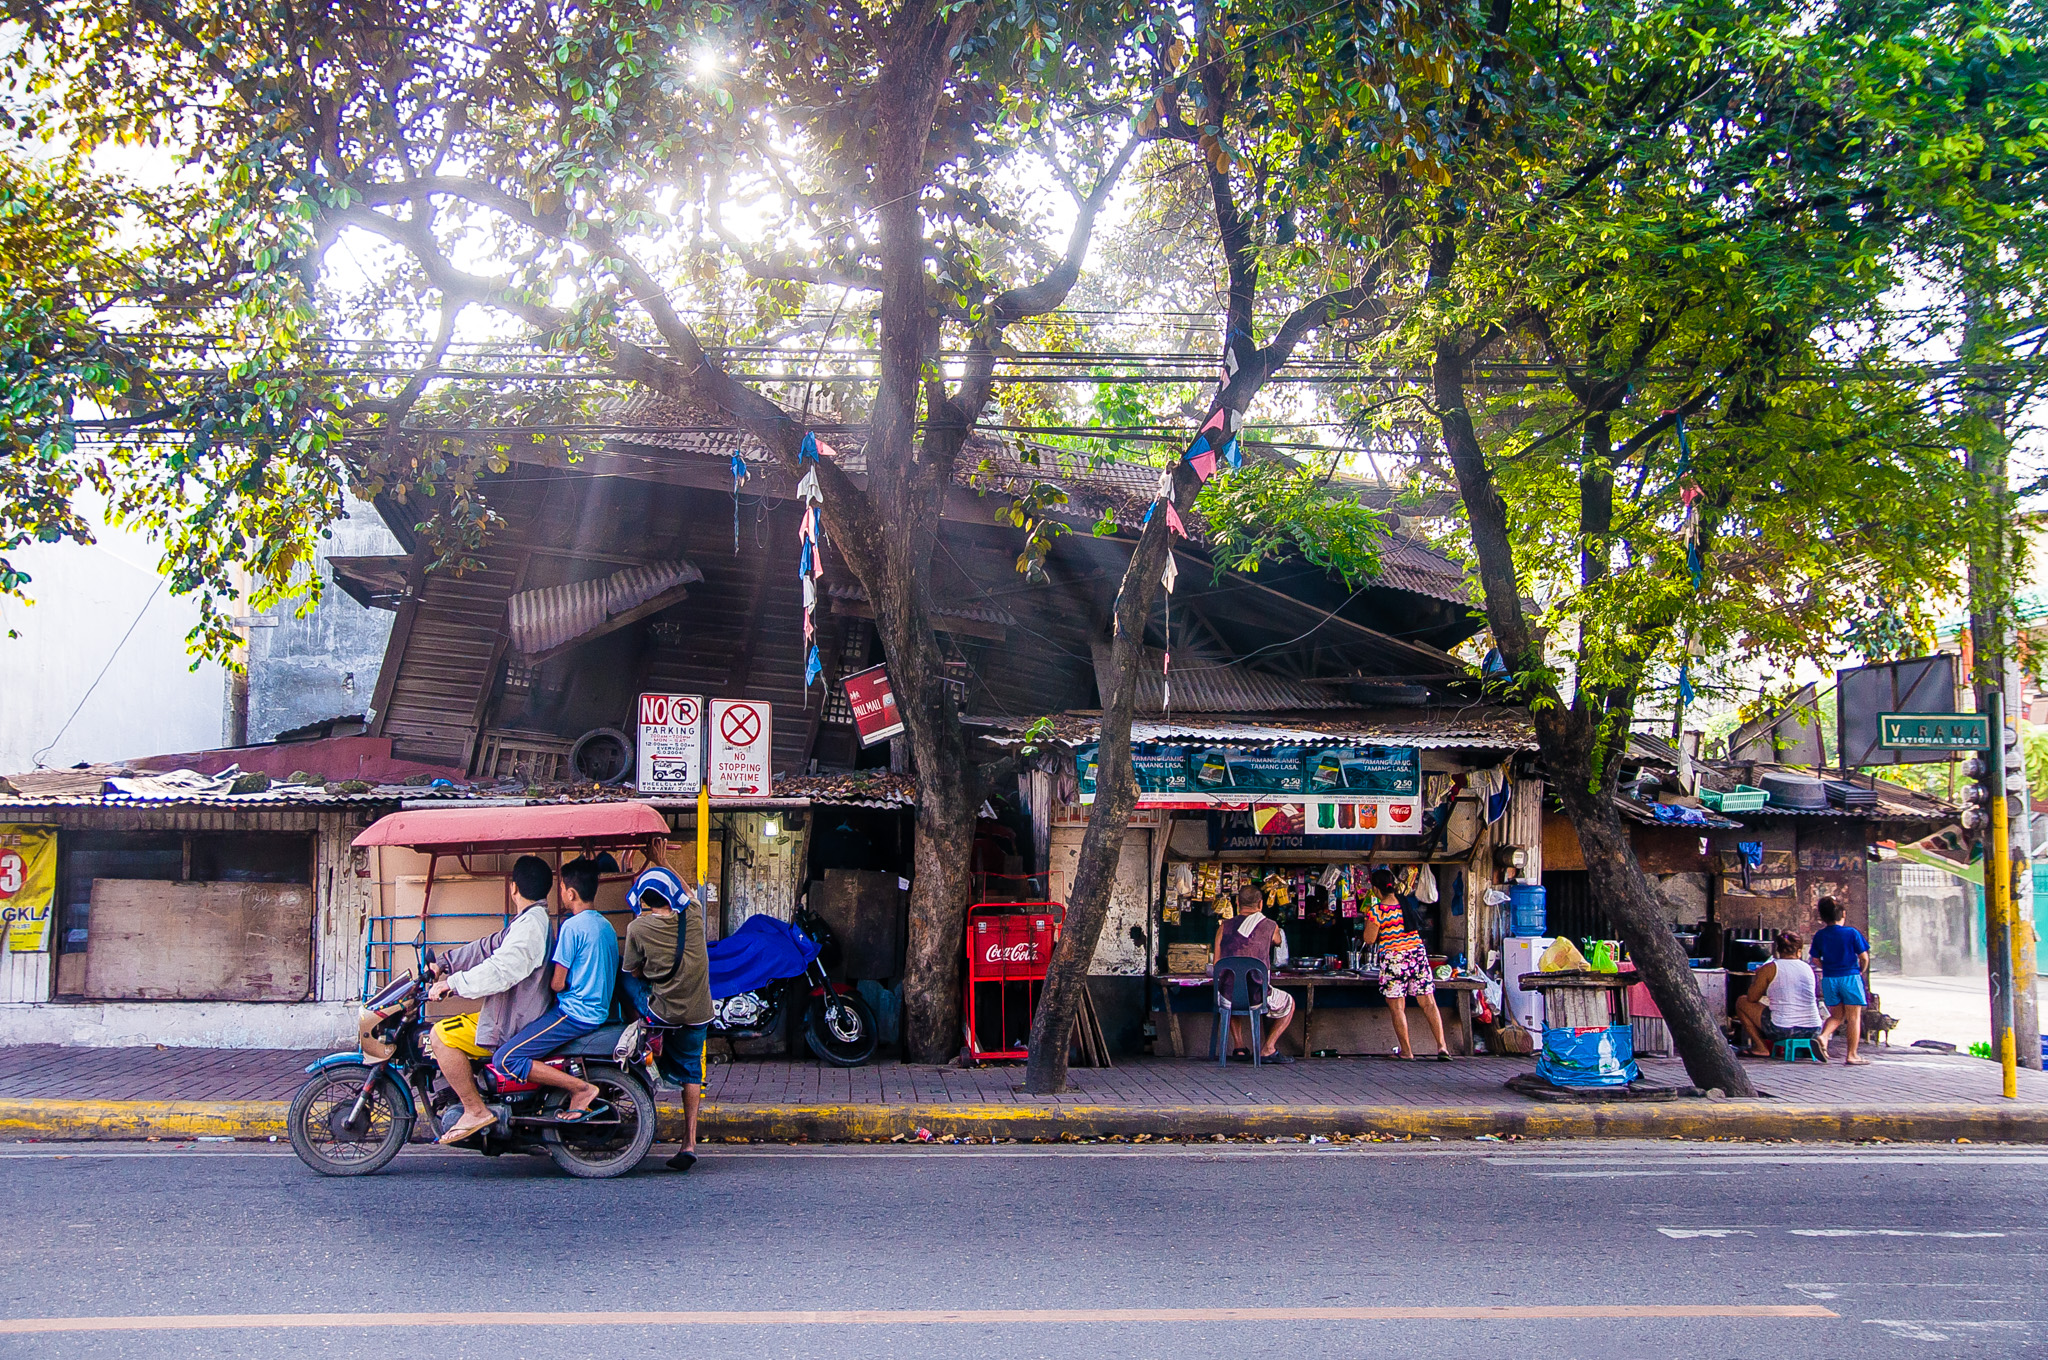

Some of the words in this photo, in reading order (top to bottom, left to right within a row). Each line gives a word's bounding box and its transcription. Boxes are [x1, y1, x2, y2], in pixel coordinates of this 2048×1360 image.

[642, 697, 667, 724] NO
[853, 704, 868, 718] PALL
[865, 699, 882, 713] MALL
[645, 726, 695, 736] PARKING
[1918, 725, 1981, 738] RAMA
[1950, 737, 1980, 745] ROAD
[734, 753, 746, 761] NO
[1162, 755, 1186, 763] LAMIG.
[718, 763, 761, 773] STOPPING
[1280, 763, 1299, 771] LASA.
[1392, 765, 1412, 773] LASA.
[720, 772, 760, 782] ANYTIME
[1229, 836, 1260, 847] ARAW
[985, 943, 1039, 962] Coca-Cola
